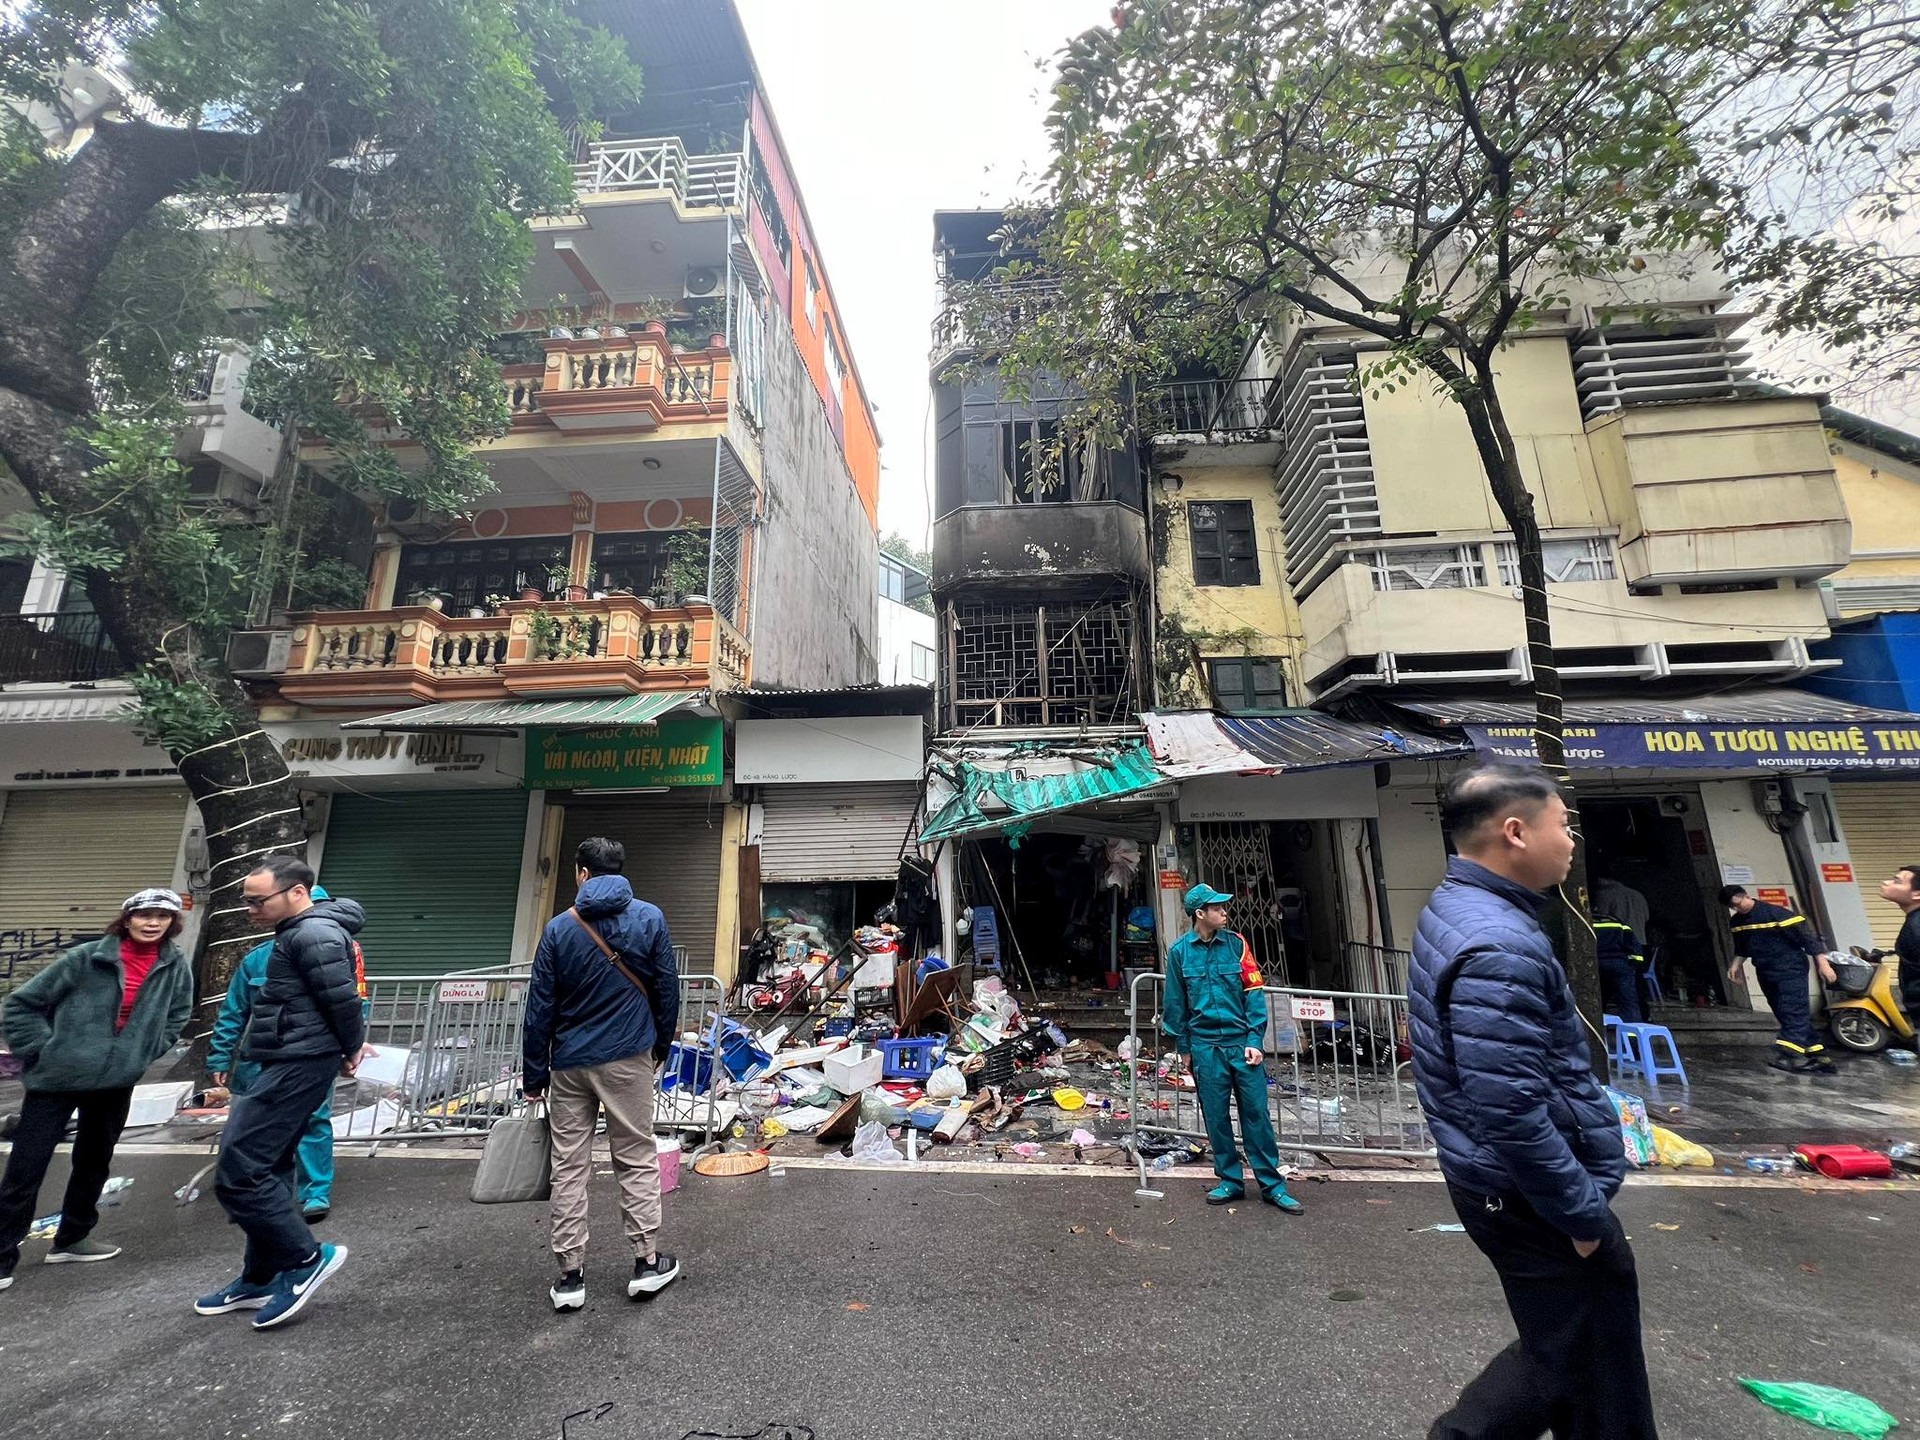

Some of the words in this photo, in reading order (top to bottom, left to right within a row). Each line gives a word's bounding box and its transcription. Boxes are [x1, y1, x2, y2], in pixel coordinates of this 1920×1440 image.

[1487, 728, 1597, 737] HIMAARI
[1644, 731, 1705, 751] HOA
[1710, 729, 1778, 752] TƯƠI
[1785, 727, 1869, 756] NGHỆ
[668, 743, 710, 769] NHẬT
[1757, 758, 1843, 767] HOTLINE/ZALO:
[1845, 758, 1874, 767] 0944
[1876, 758, 1896, 767] 497
[1299, 1008, 1325, 1016] STOP
